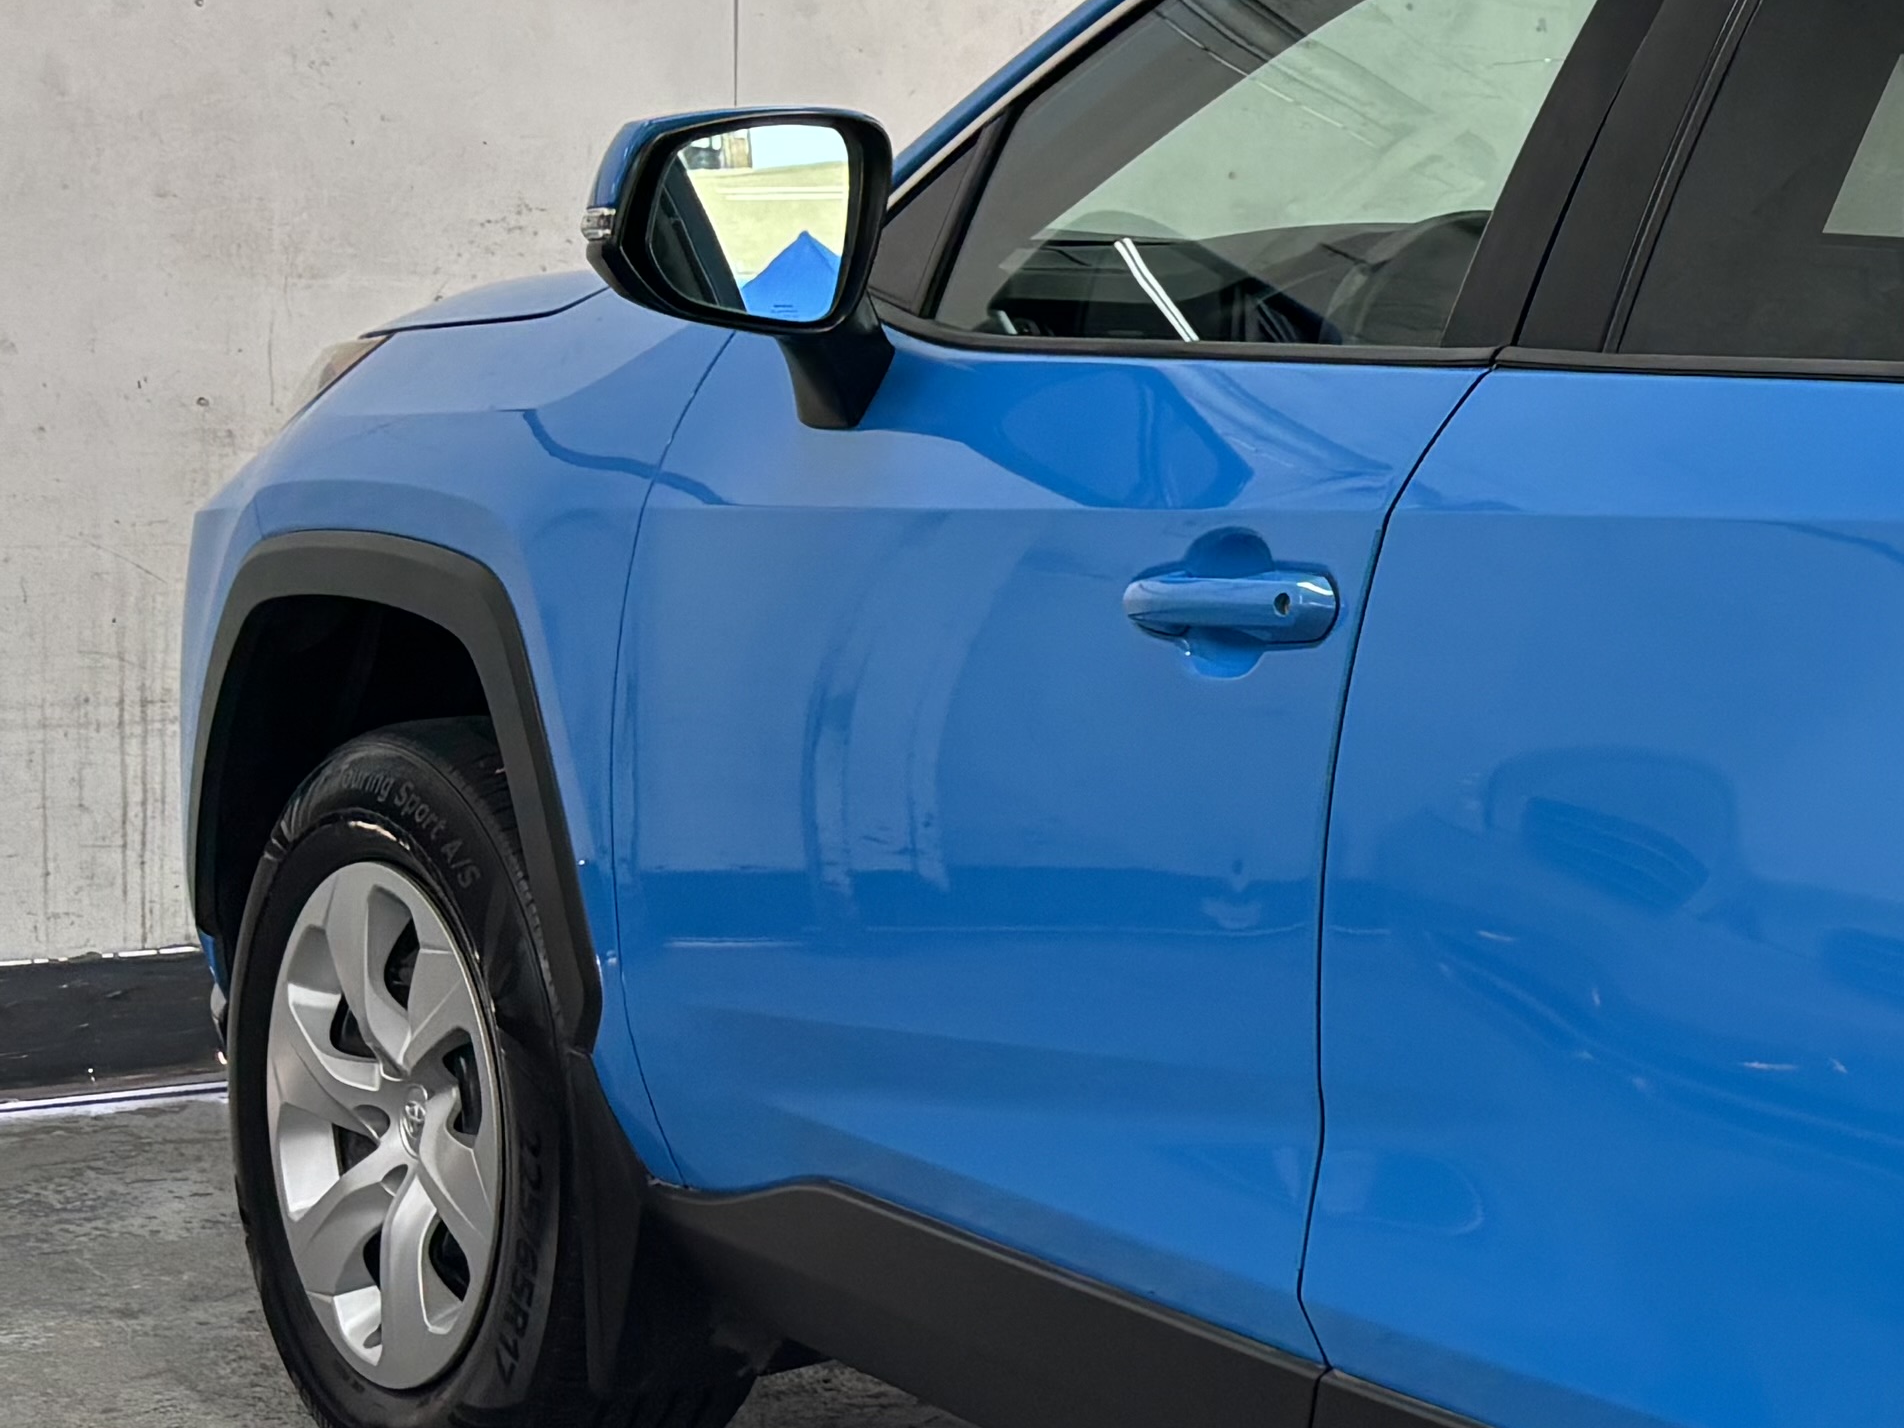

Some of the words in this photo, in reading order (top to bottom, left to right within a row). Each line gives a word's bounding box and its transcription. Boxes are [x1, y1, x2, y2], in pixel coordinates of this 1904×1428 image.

[393, 780, 447, 841] Sport
[440, 838, 481, 889] A/S
[495, 1129, 544, 1386] 225/65R17
